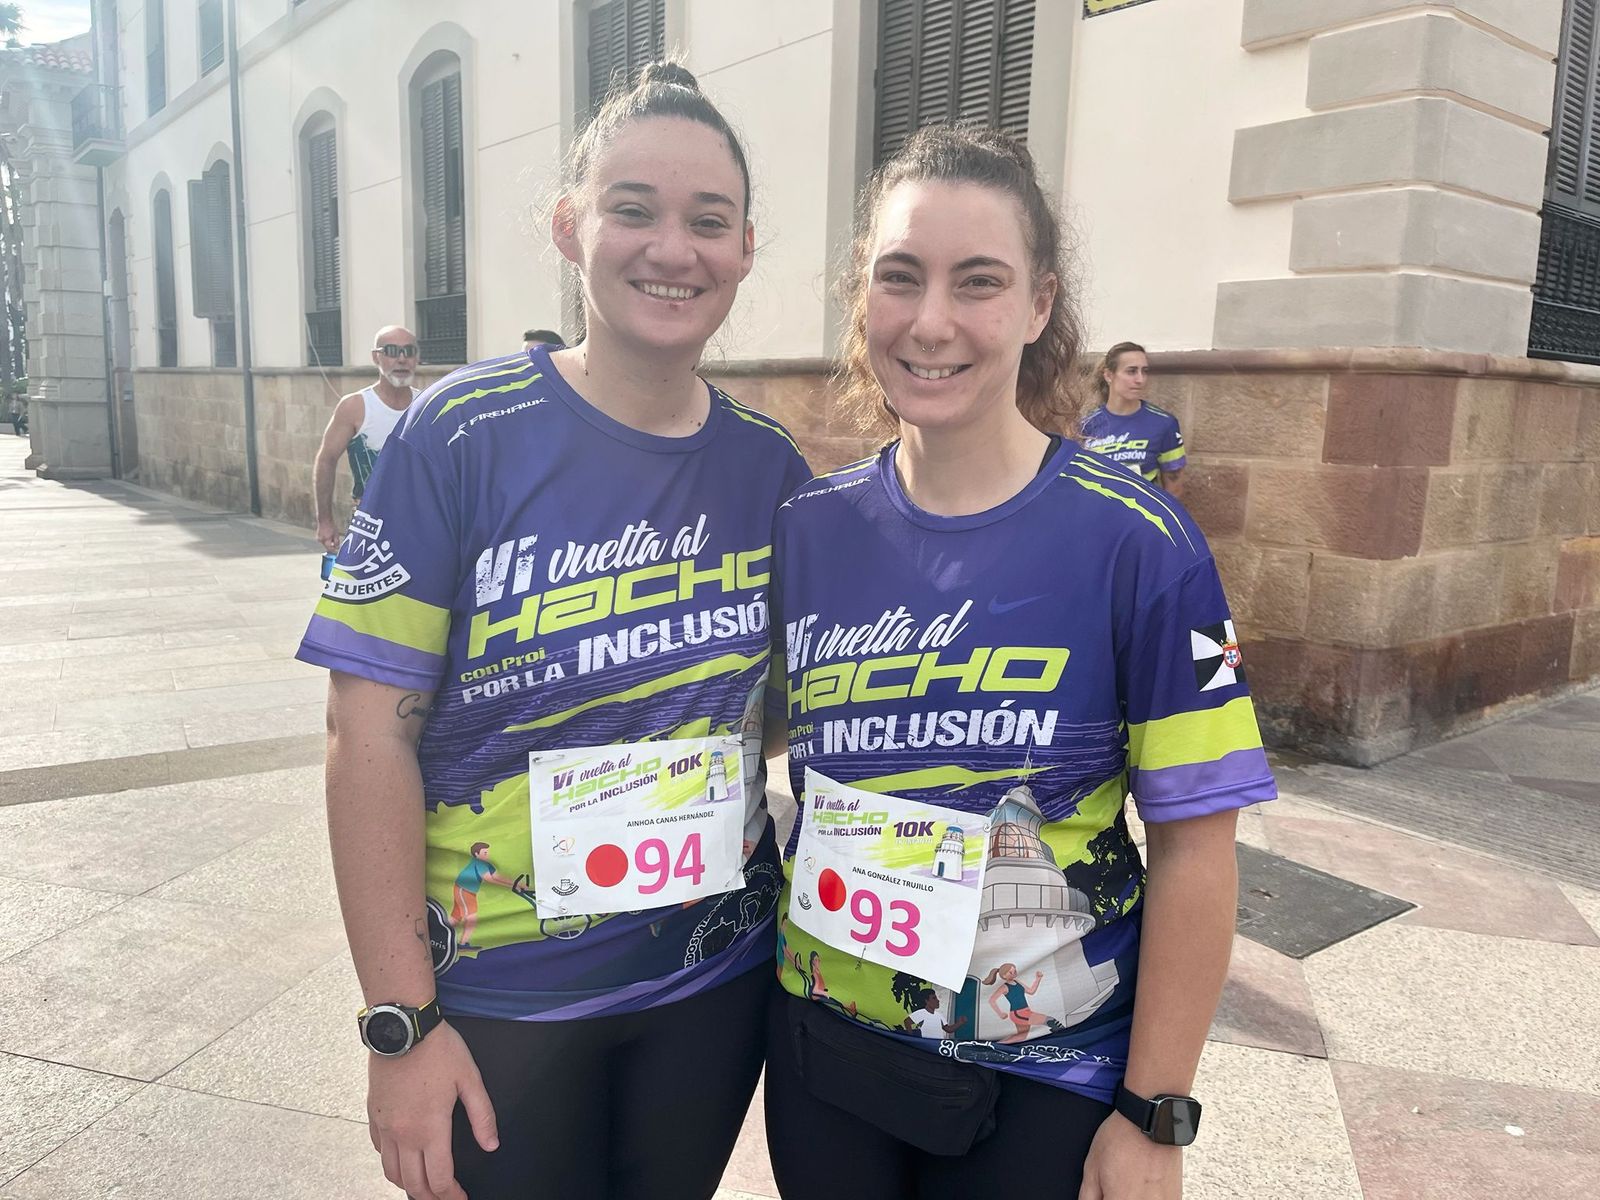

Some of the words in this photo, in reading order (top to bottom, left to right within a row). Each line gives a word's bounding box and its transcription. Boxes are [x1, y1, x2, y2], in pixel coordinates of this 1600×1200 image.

[548, 519, 668, 583] vuelta
[671, 513, 710, 560] al
[333, 570, 403, 596] FUERTES
[815, 606, 919, 663] vuelta
[918, 599, 974, 651] al
[460, 663, 500, 682] con
[502, 646, 546, 671] Proi
[462, 675, 520, 704] POR
[524, 662, 565, 687] LA
[577, 592, 770, 675] INCLUSIÓ
[788, 742, 806, 761] POR
[823, 699, 1059, 754] INCLUSIÓN
[580, 758, 617, 782] vuelta
[618, 753, 632, 769] al
[667, 752, 704, 778] 10K
[569, 801, 586, 813] POR
[587, 798, 599, 806] LA
[599, 773, 658, 802] INCLUSIÓN
[826, 798, 847, 811] vuelta
[847, 799, 860, 812] al
[627, 818, 655, 828] AINHOA
[655, 815, 678, 825] CANAS
[678, 811, 715, 822] HERNÁNDEZ
[833, 825, 882, 837] INCLUSIÓN
[893, 820, 936, 838] 10K
[634, 833, 705, 894] 94
[852, 866, 867, 876] ANA
[867, 870, 901, 886] GONZÁLEZ
[902, 879, 934, 893] TRUJILLO
[850, 889, 921, 957] 93
